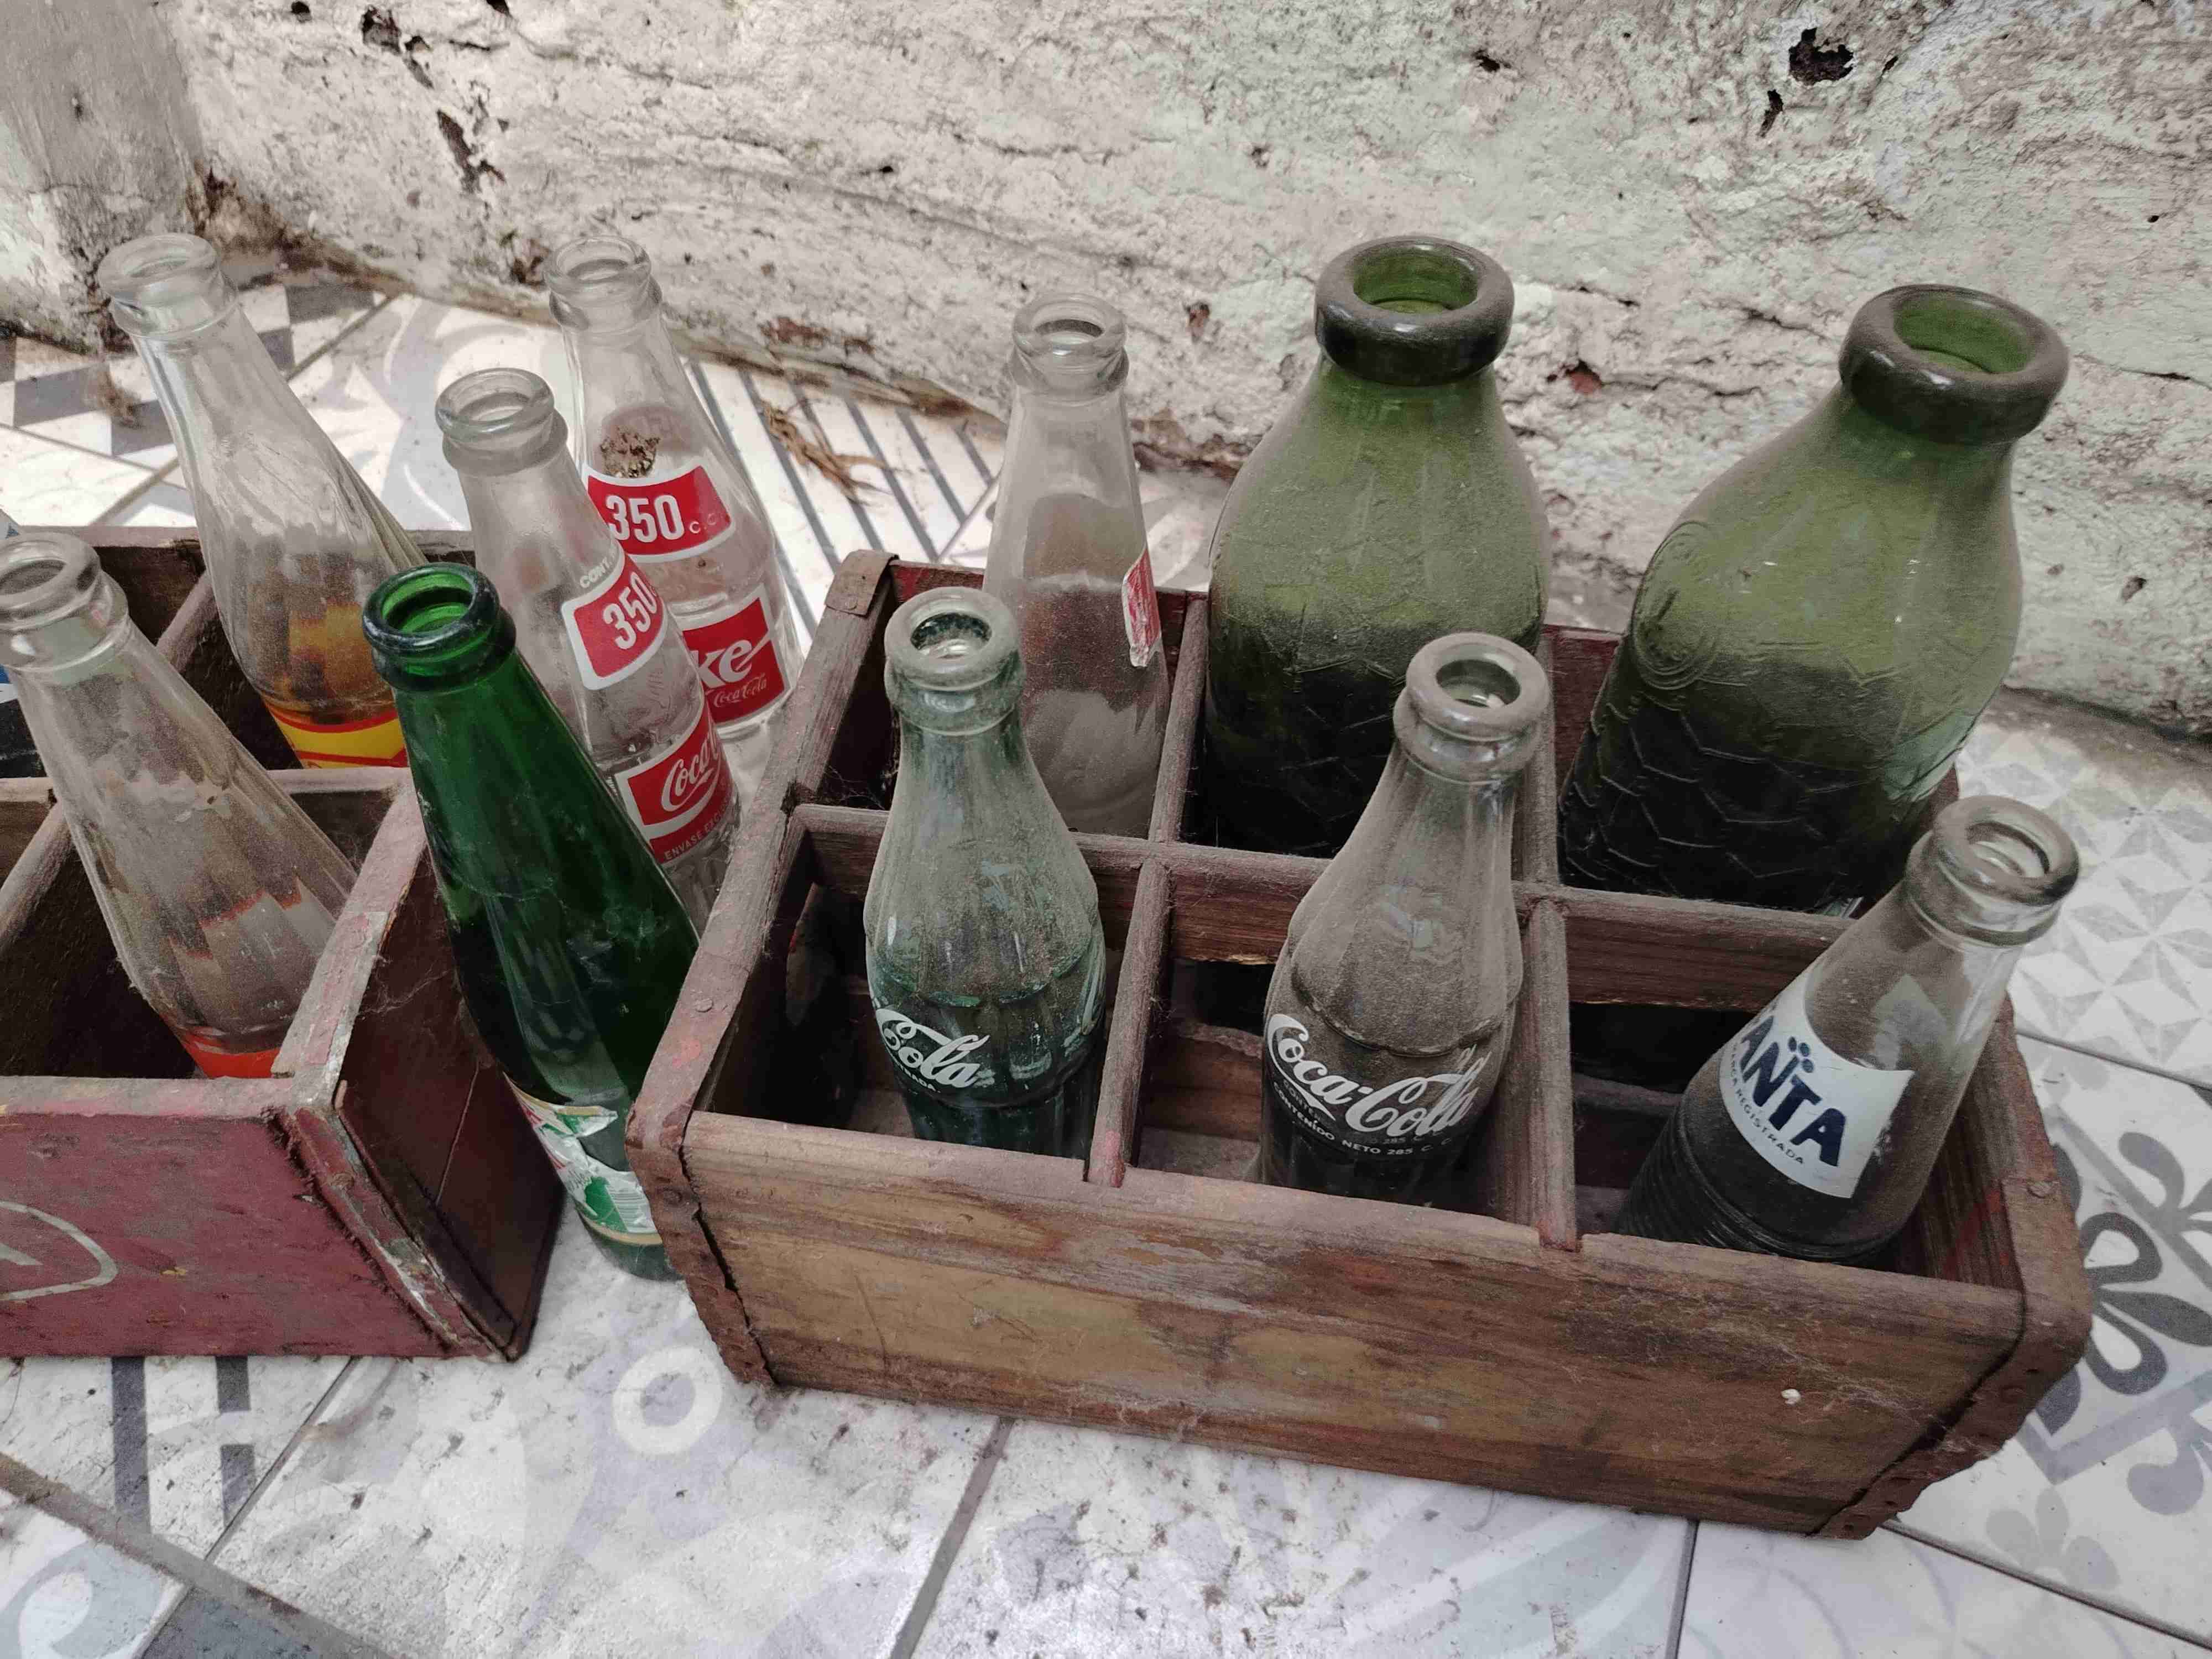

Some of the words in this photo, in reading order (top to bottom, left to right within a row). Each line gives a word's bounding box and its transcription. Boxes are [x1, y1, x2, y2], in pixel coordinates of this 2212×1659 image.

[606, 495, 685, 543] 350
[603, 571, 658, 650] 350
[690, 639, 770, 689] ke
[1267, 1013, 1493, 1137] Coca-Cola
[1741, 1015, 1846, 1167] ANTA
[1342, 1139, 1381, 1154] NETO
